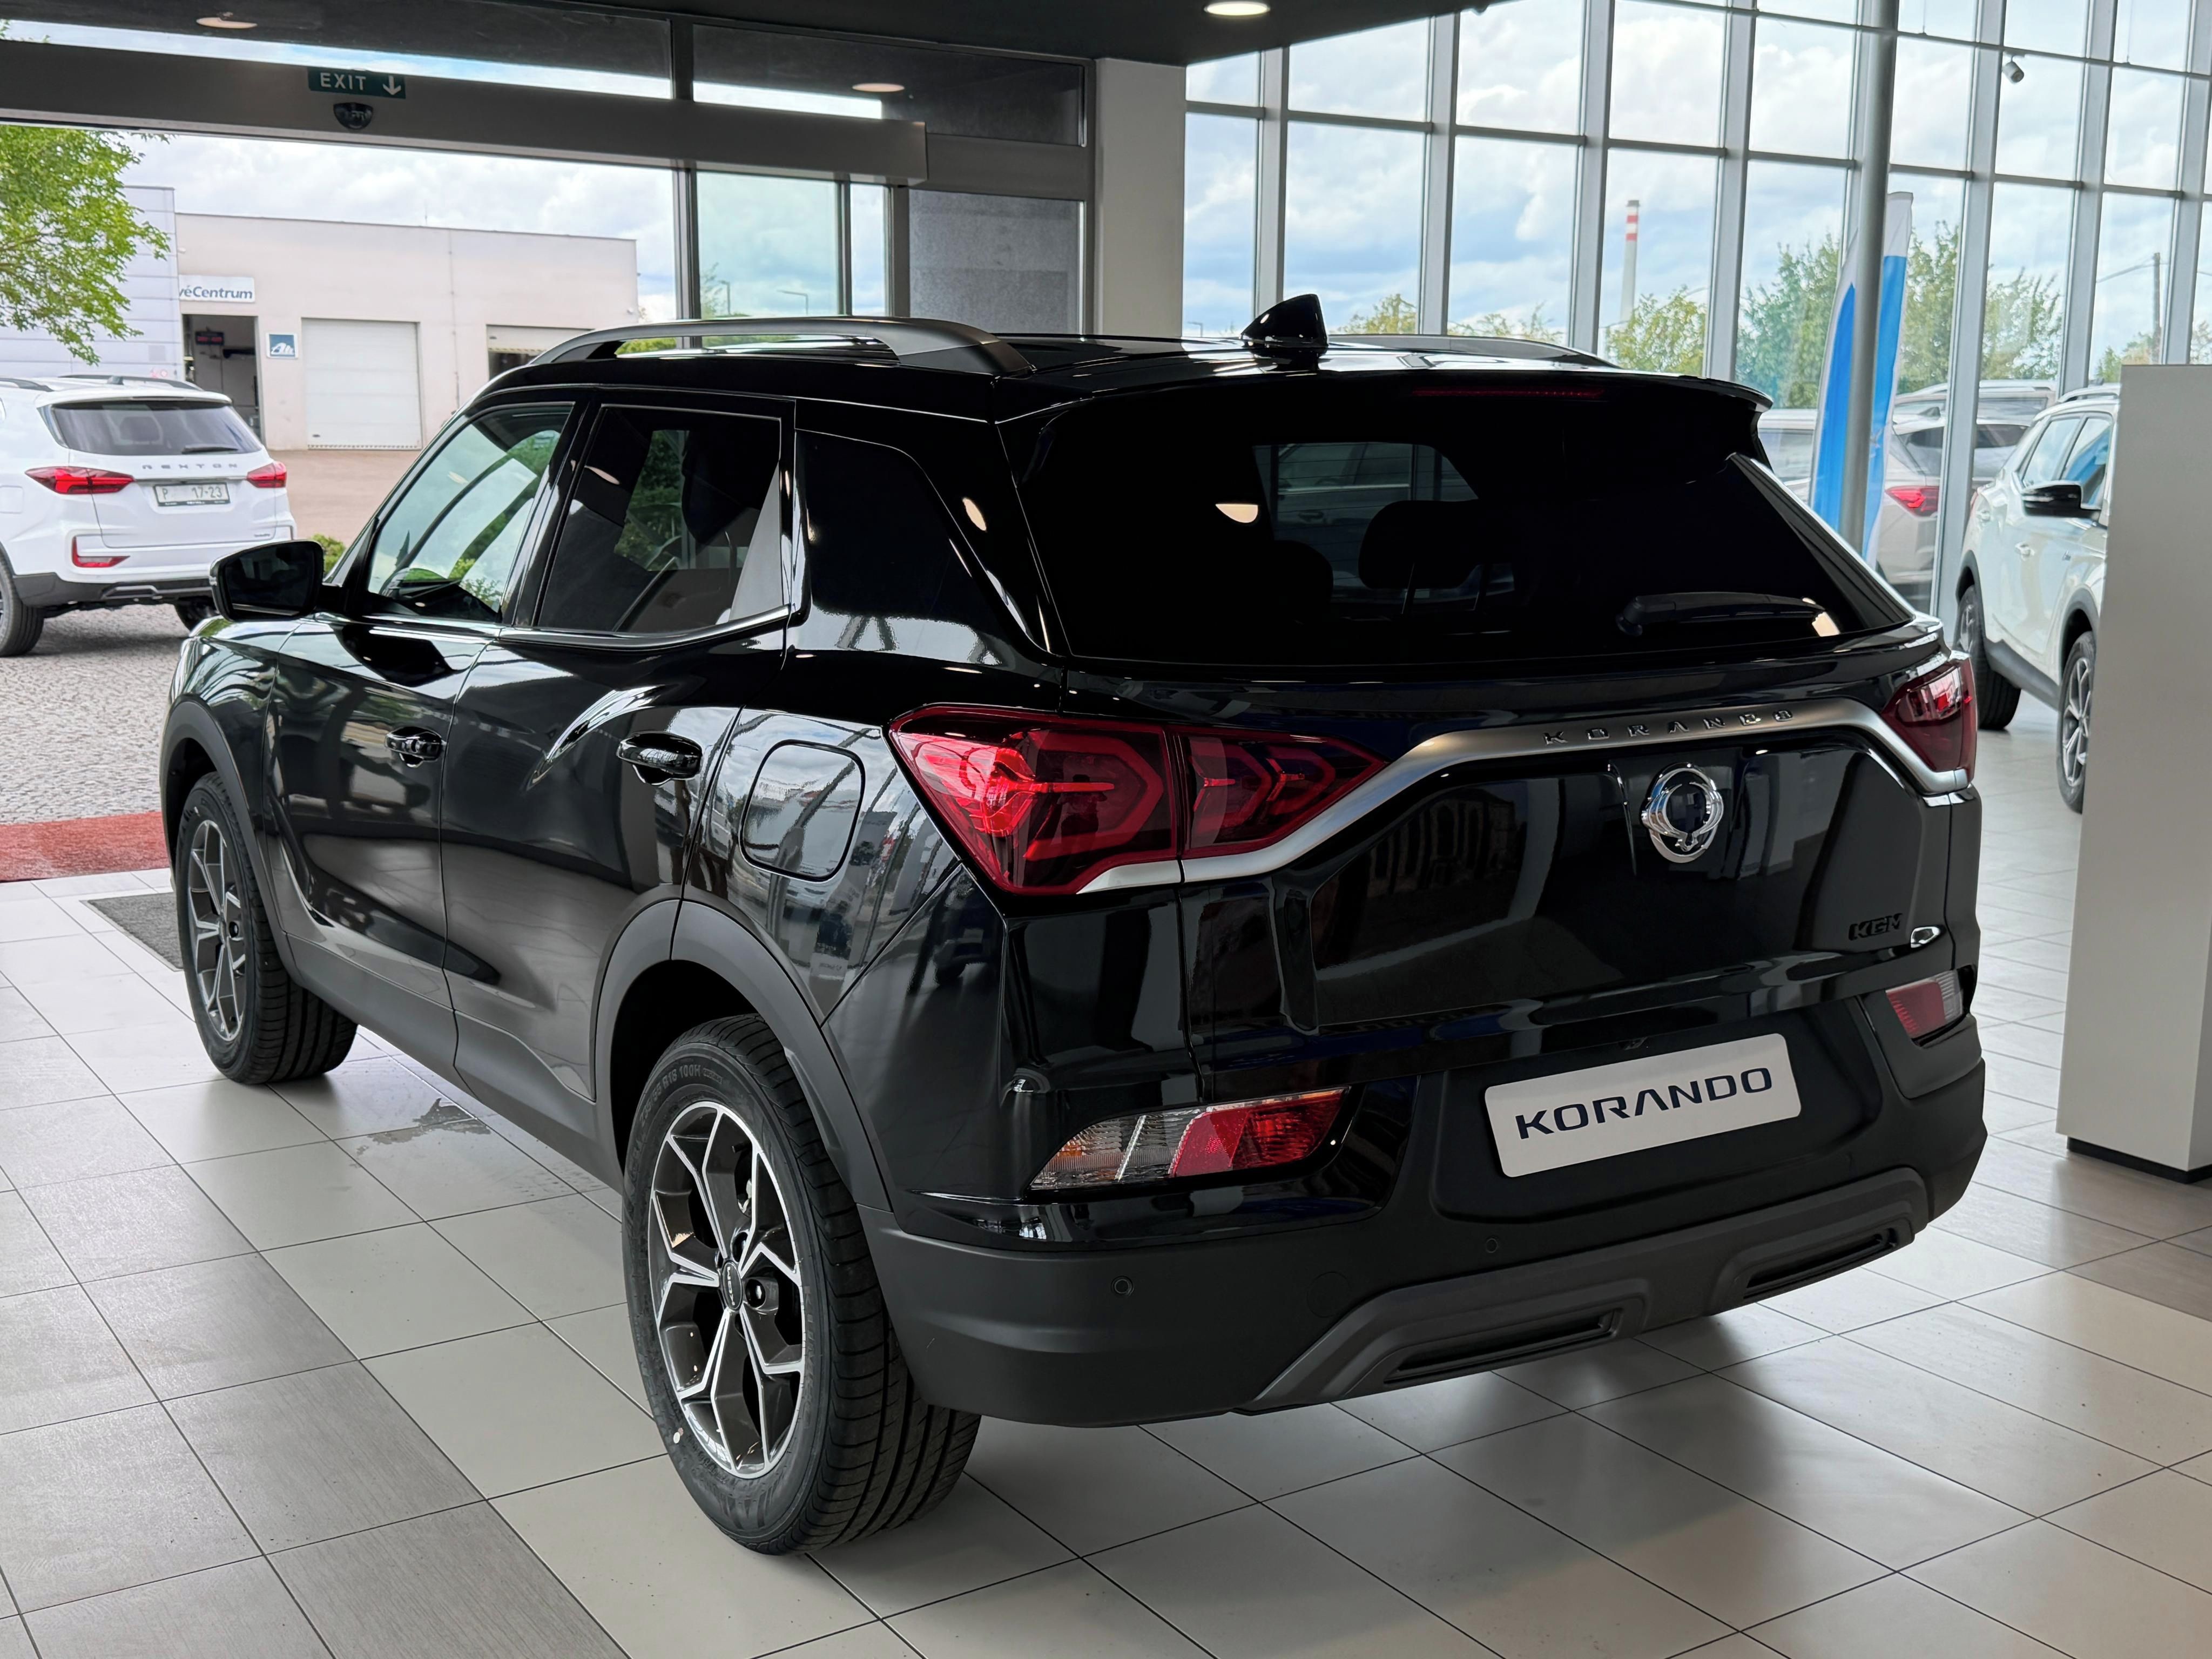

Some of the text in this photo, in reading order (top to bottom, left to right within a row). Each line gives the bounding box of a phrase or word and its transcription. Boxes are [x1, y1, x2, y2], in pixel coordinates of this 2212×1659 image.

[320, 72, 366, 91] EXIT
[192, 486, 222, 498] 17-23
[1543, 710, 1793, 745] KORANDO
[662, 1069, 677, 1089] R18
[679, 1064, 701, 1078] 100H
[1515, 1067, 1772, 1139] KORANDO
